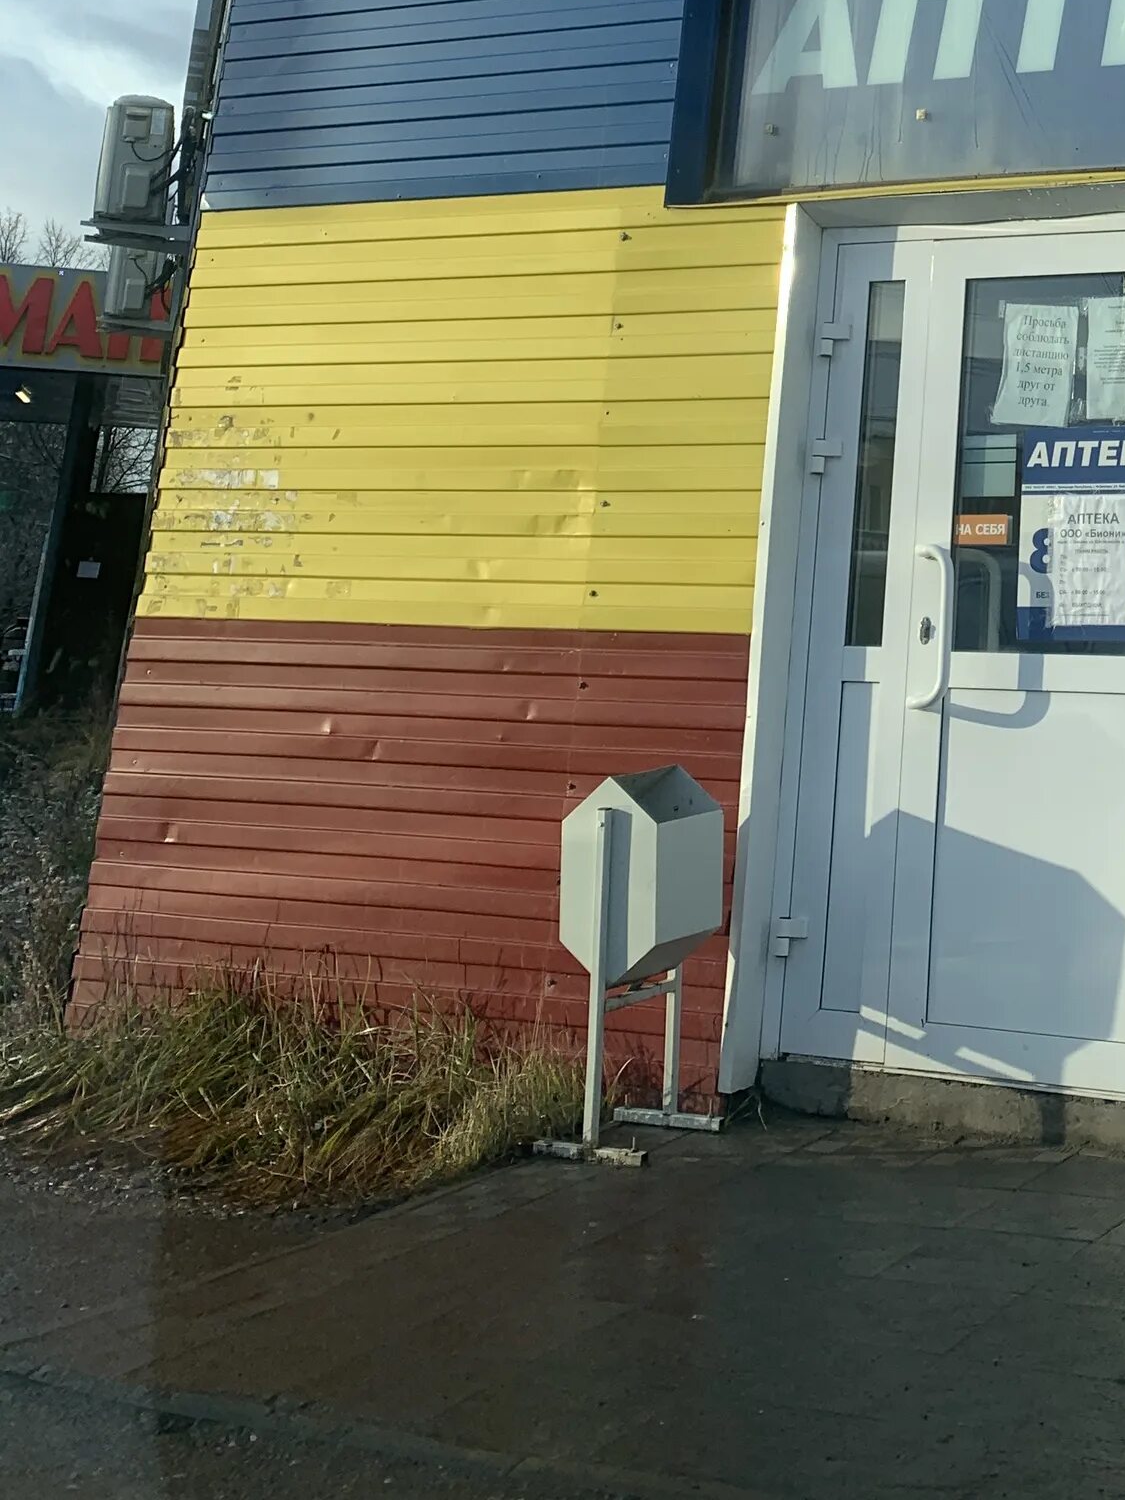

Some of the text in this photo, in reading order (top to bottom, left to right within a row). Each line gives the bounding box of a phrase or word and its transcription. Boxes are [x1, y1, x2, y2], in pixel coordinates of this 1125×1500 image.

[1023, 314, 1067, 329] Просьба
[1016, 332, 1070, 345] соблюдать
[1013, 347, 1069, 360] дистанцию
[1033, 366, 1063, 378] метра
[1016, 380, 1056, 392] друг от
[1067, 512, 1120, 525] АПТЕКА
[955, 523, 1006, 536] НА СЕБЯ
[1060, 528, 1082, 539] ООО
